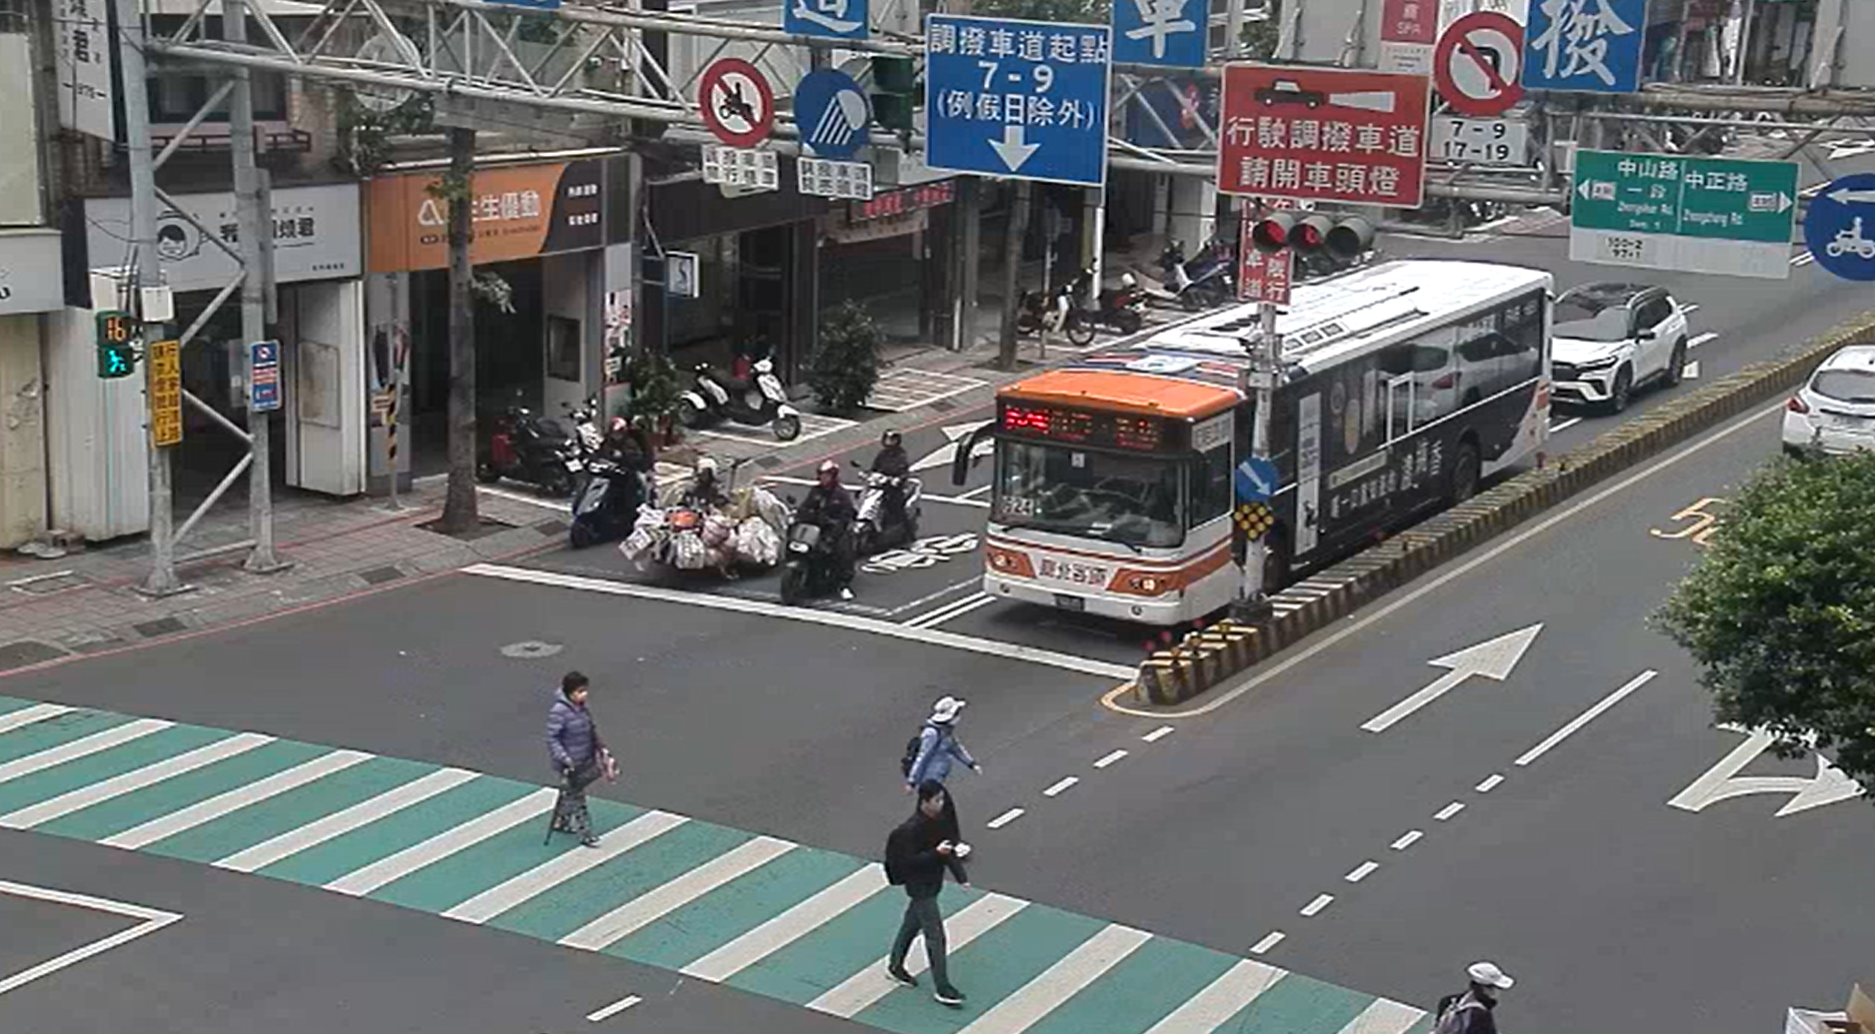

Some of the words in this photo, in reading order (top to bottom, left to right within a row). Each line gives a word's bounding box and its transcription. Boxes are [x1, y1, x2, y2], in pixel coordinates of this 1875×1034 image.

[929, 23, 1108, 65] 調撥車道起點
[935, 88, 1096, 130] (例假日除外)
[1226, 115, 1421, 158] 行駛調撥車道
[1451, 120, 1506, 139] 7-9
[1444, 143, 1510, 161] 17-19
[1239, 155, 1401, 197] 請開車頭燈
[1617, 158, 1679, 181] 中山路
[1684, 168, 1749, 192] 中正路
[107, 317, 126, 341] 16
